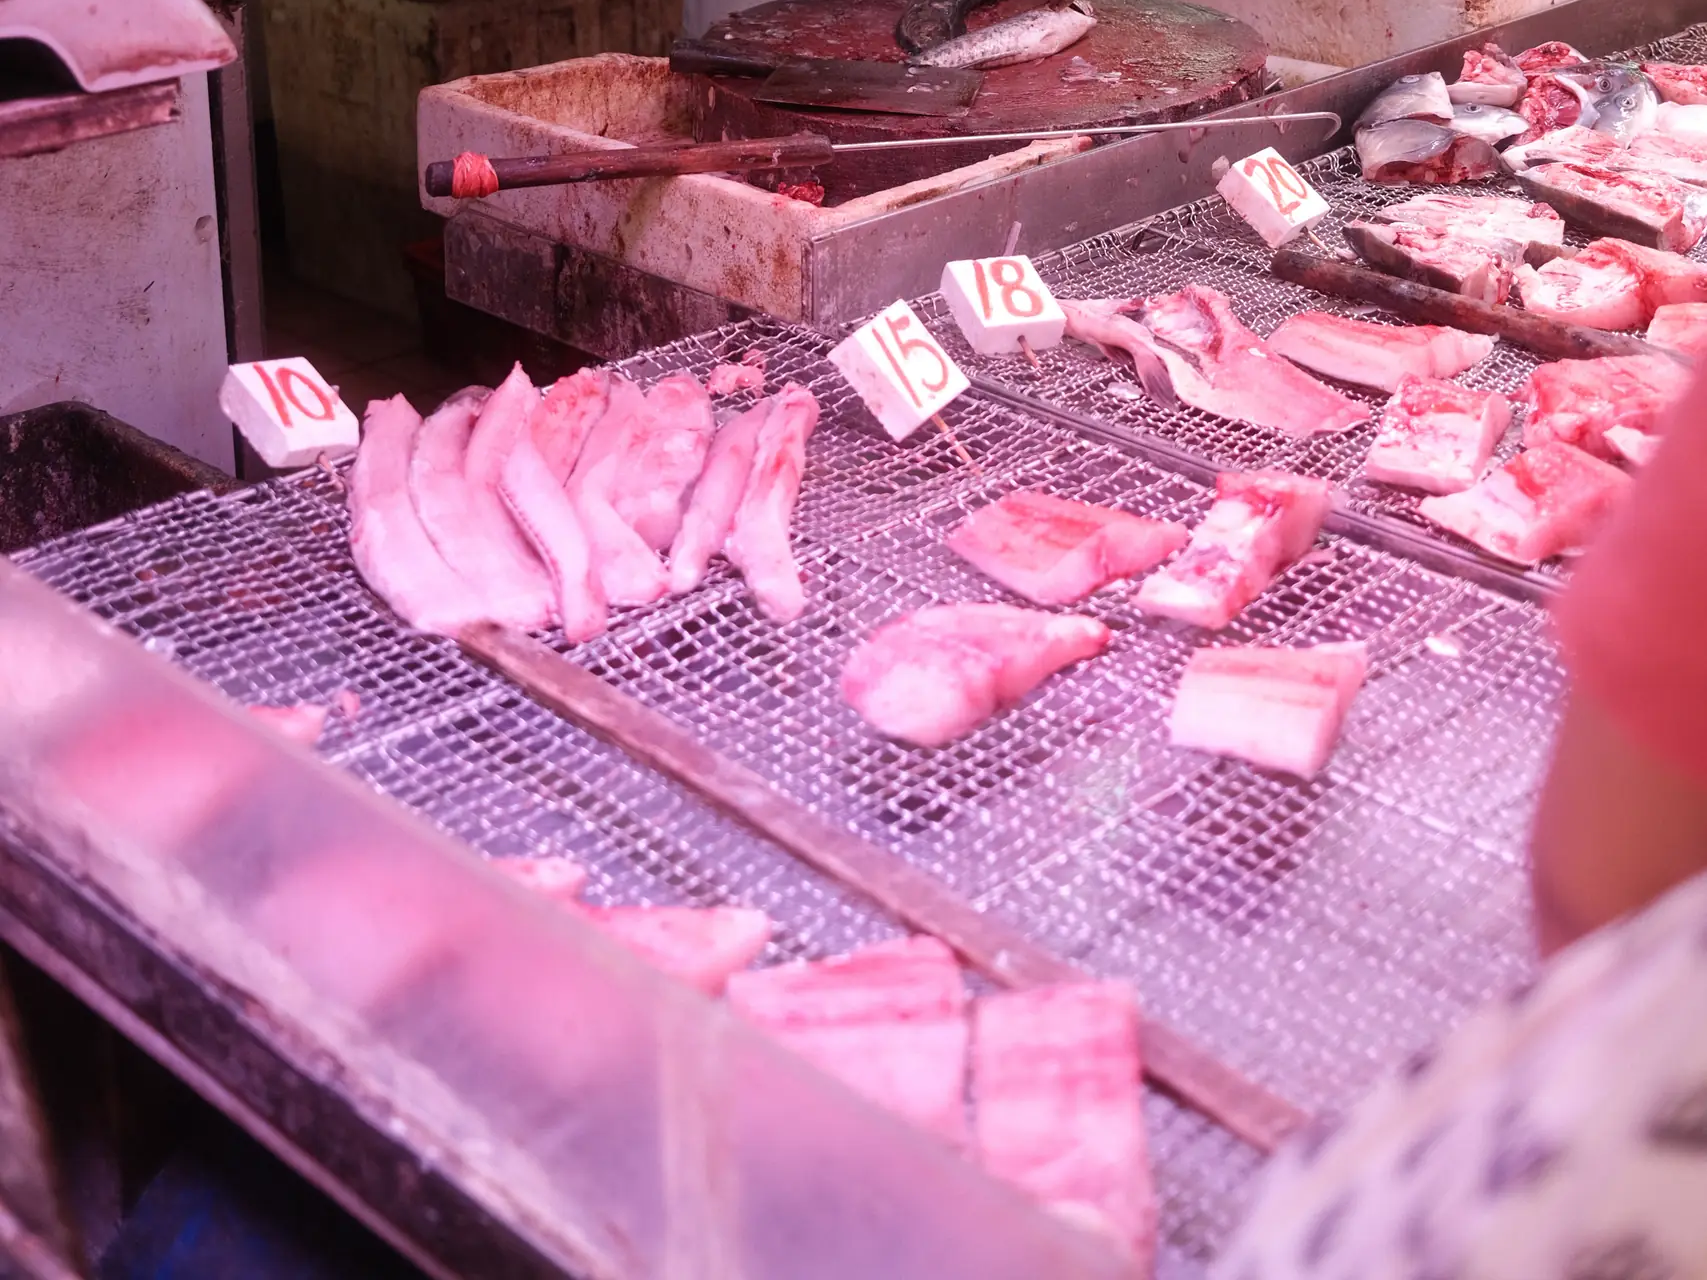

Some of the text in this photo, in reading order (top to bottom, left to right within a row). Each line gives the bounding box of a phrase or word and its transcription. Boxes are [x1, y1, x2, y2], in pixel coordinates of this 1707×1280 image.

[1243, 157, 1308, 215] 20
[972, 259, 1044, 320] 18
[871, 315, 949, 409] 15
[252, 361, 335, 428] 10
